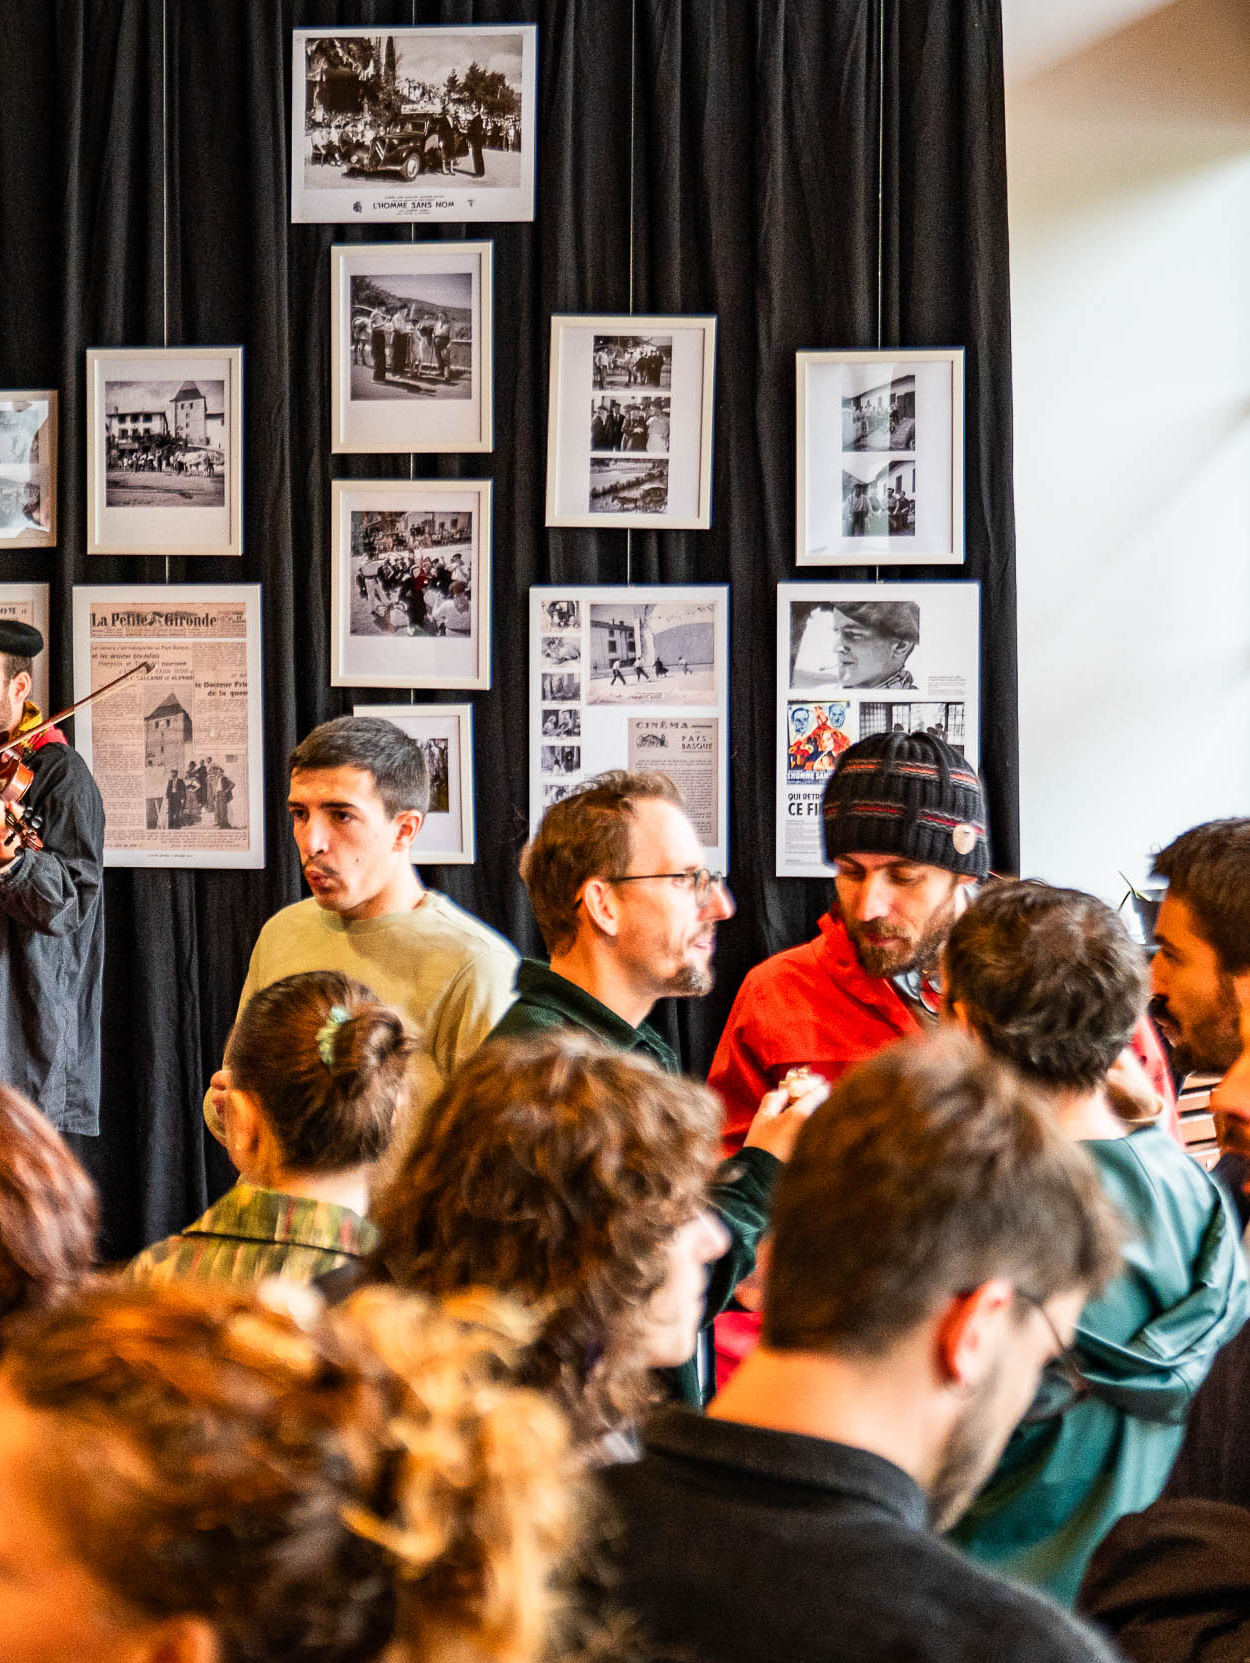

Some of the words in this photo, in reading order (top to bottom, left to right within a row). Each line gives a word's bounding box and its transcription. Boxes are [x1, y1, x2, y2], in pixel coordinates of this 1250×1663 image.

[372, 201, 408, 210] L'HOMME
[411, 201, 432, 209] SANS
[435, 200, 455, 208] NOM
[91, 612, 108, 627] La
[111, 611, 148, 627] Petite
[164, 612, 217, 627] Gironde
[635, 720, 689, 729] CINÉMA
[787, 793, 801, 801] QUI
[788, 802, 803, 816] CE
